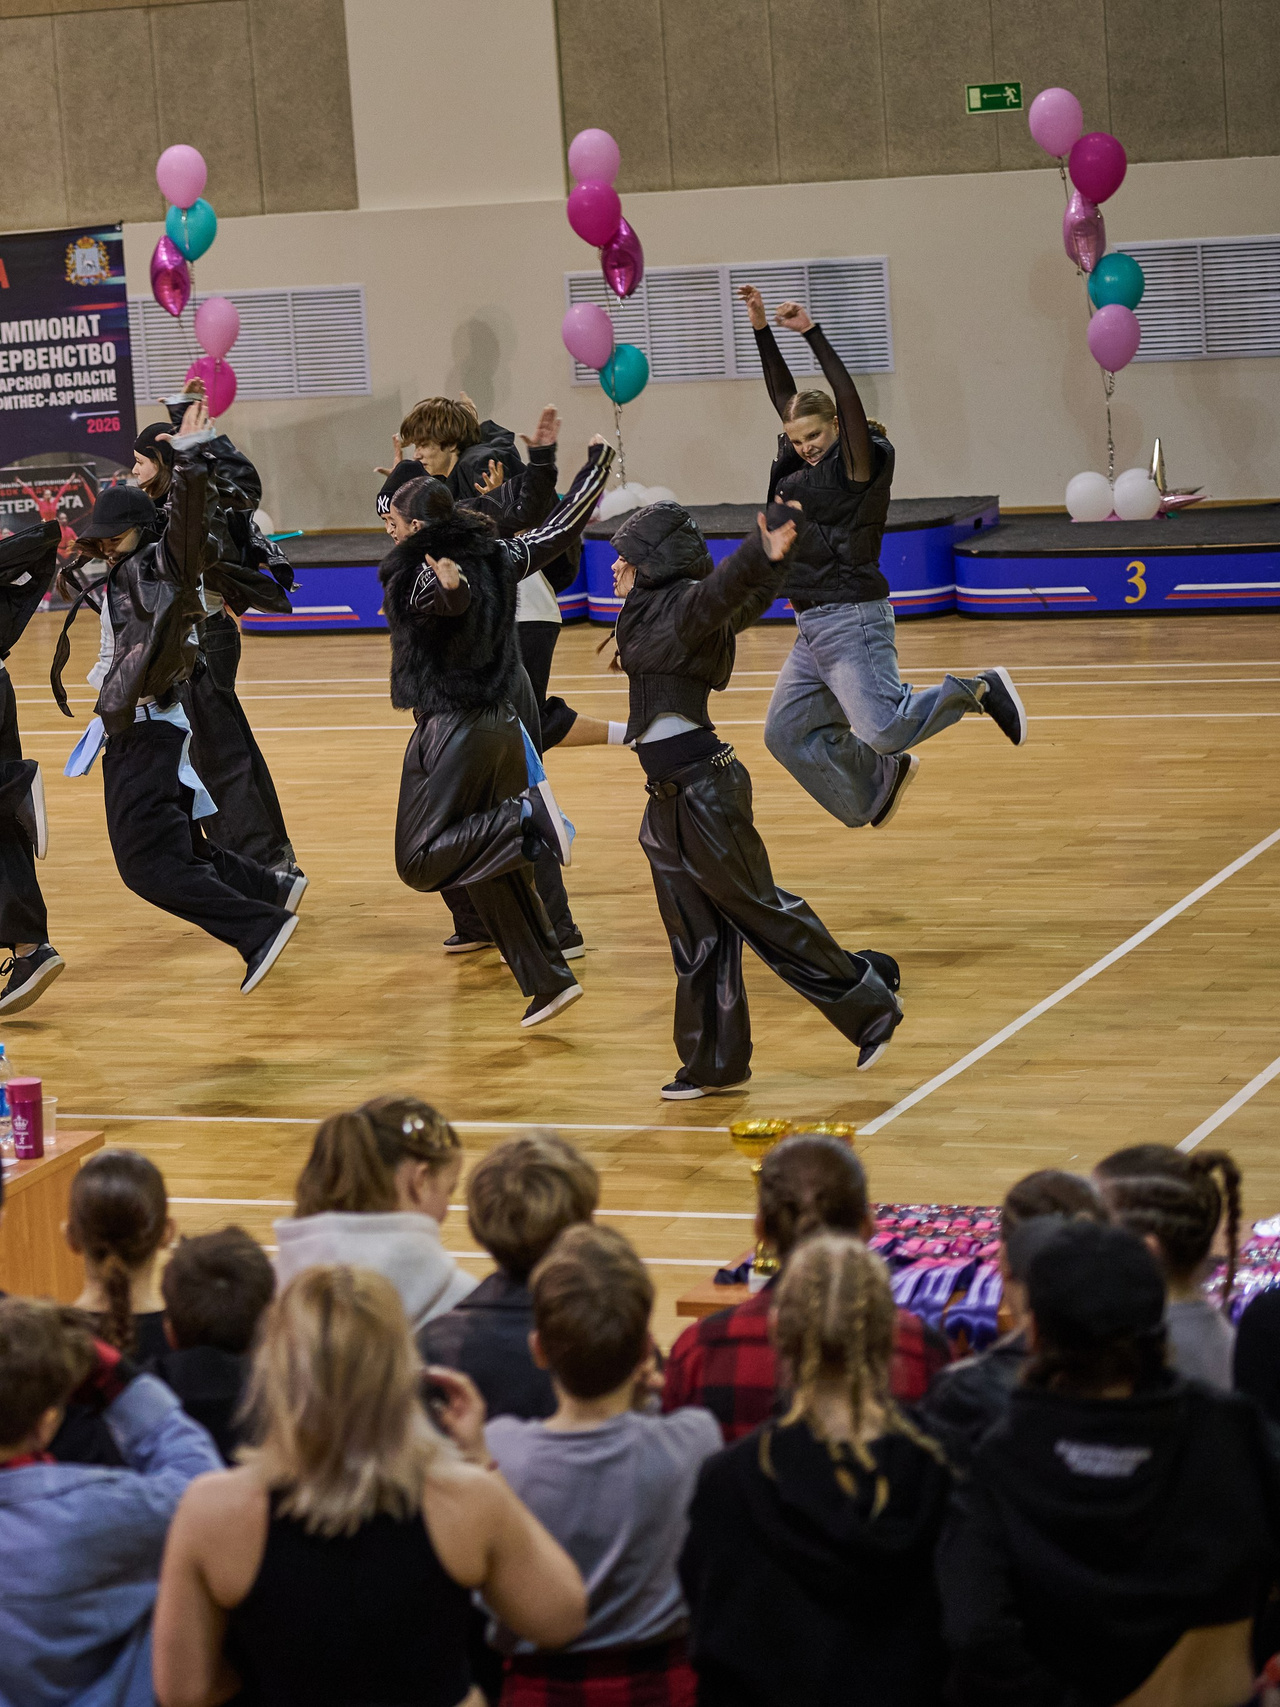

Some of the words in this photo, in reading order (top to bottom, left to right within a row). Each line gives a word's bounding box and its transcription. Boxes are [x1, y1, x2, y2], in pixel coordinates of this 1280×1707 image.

[54, 369, 117, 388] ОБЛАСТИ
[86, 417, 121, 434] 2026
[377, 495, 390, 513] NY
[1124, 560, 1147, 604] 3
